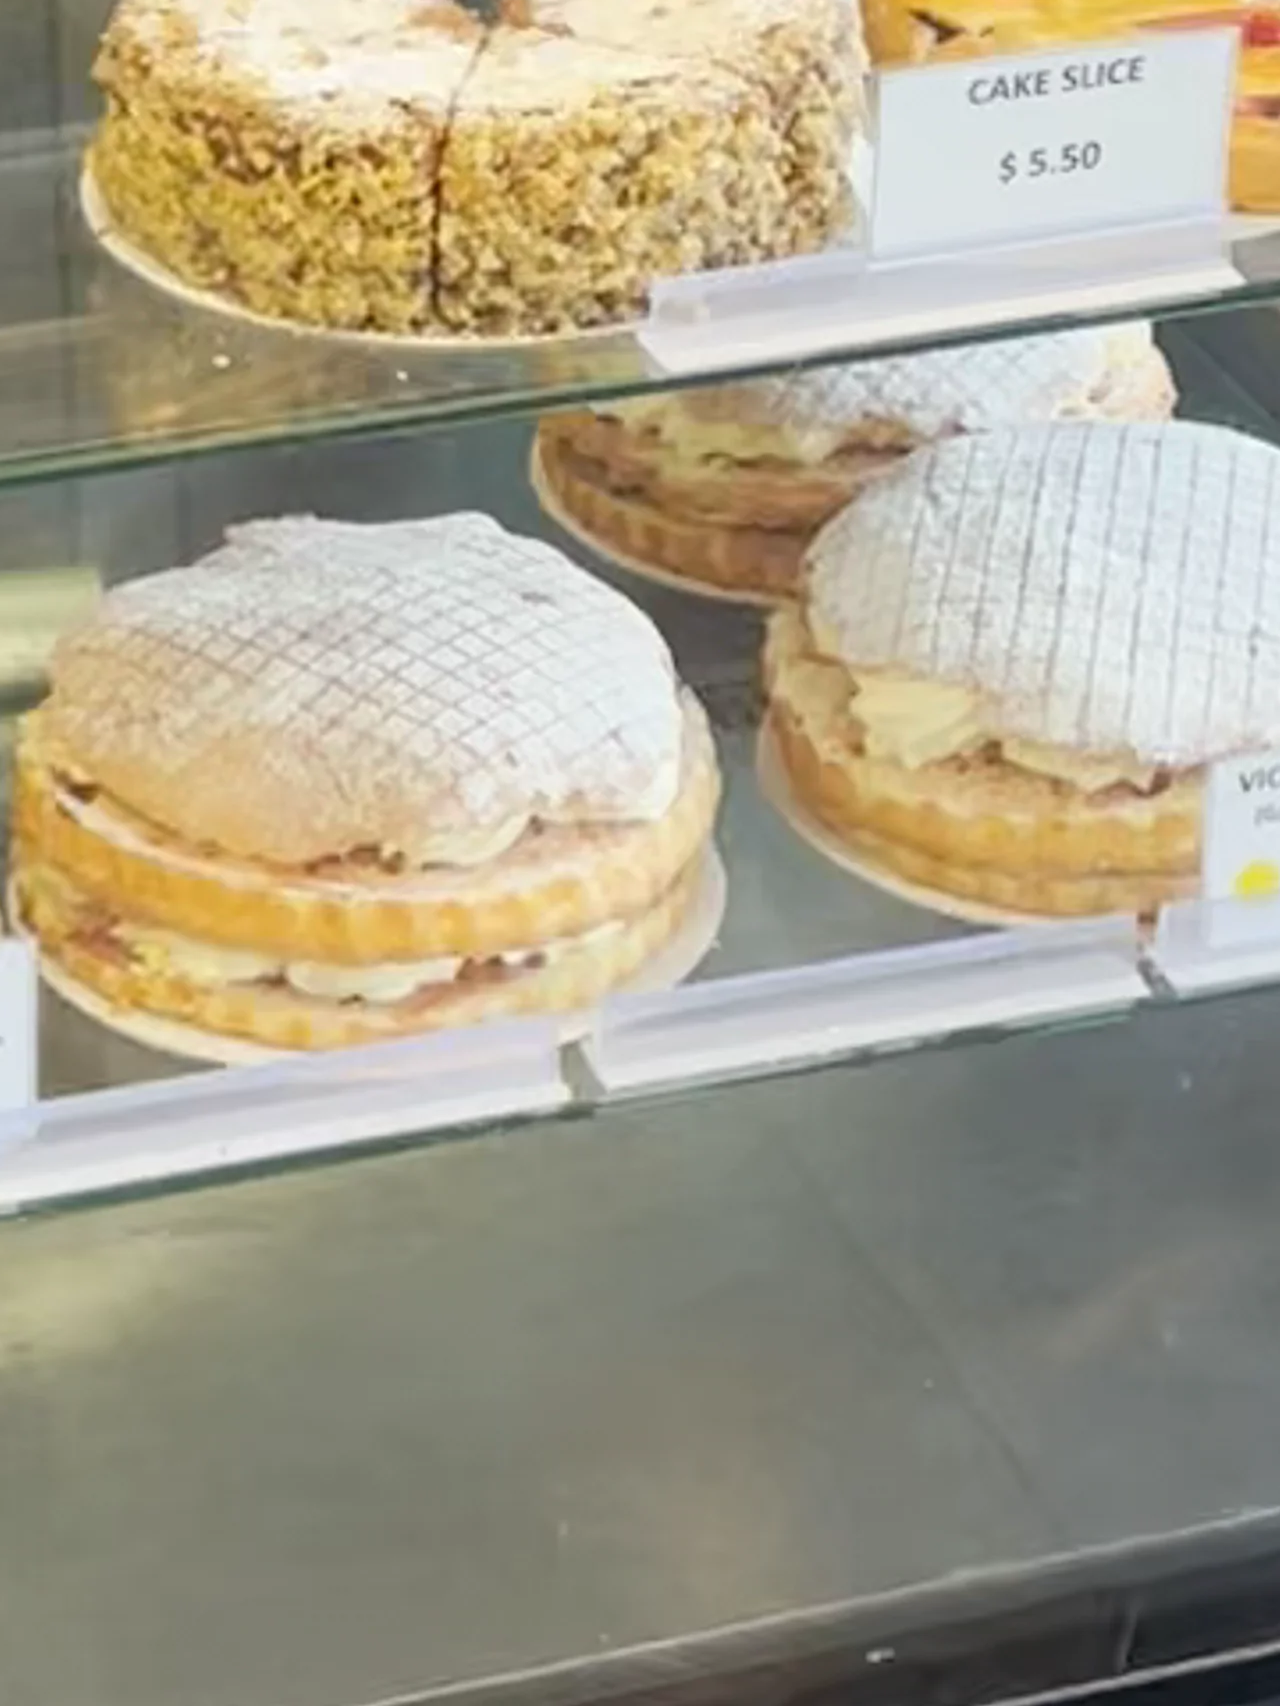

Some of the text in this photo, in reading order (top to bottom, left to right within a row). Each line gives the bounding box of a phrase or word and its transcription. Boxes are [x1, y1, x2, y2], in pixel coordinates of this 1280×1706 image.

[967, 55, 1146, 106] CAKE SLICE
[998, 140, 1102, 184] $ 5.50
